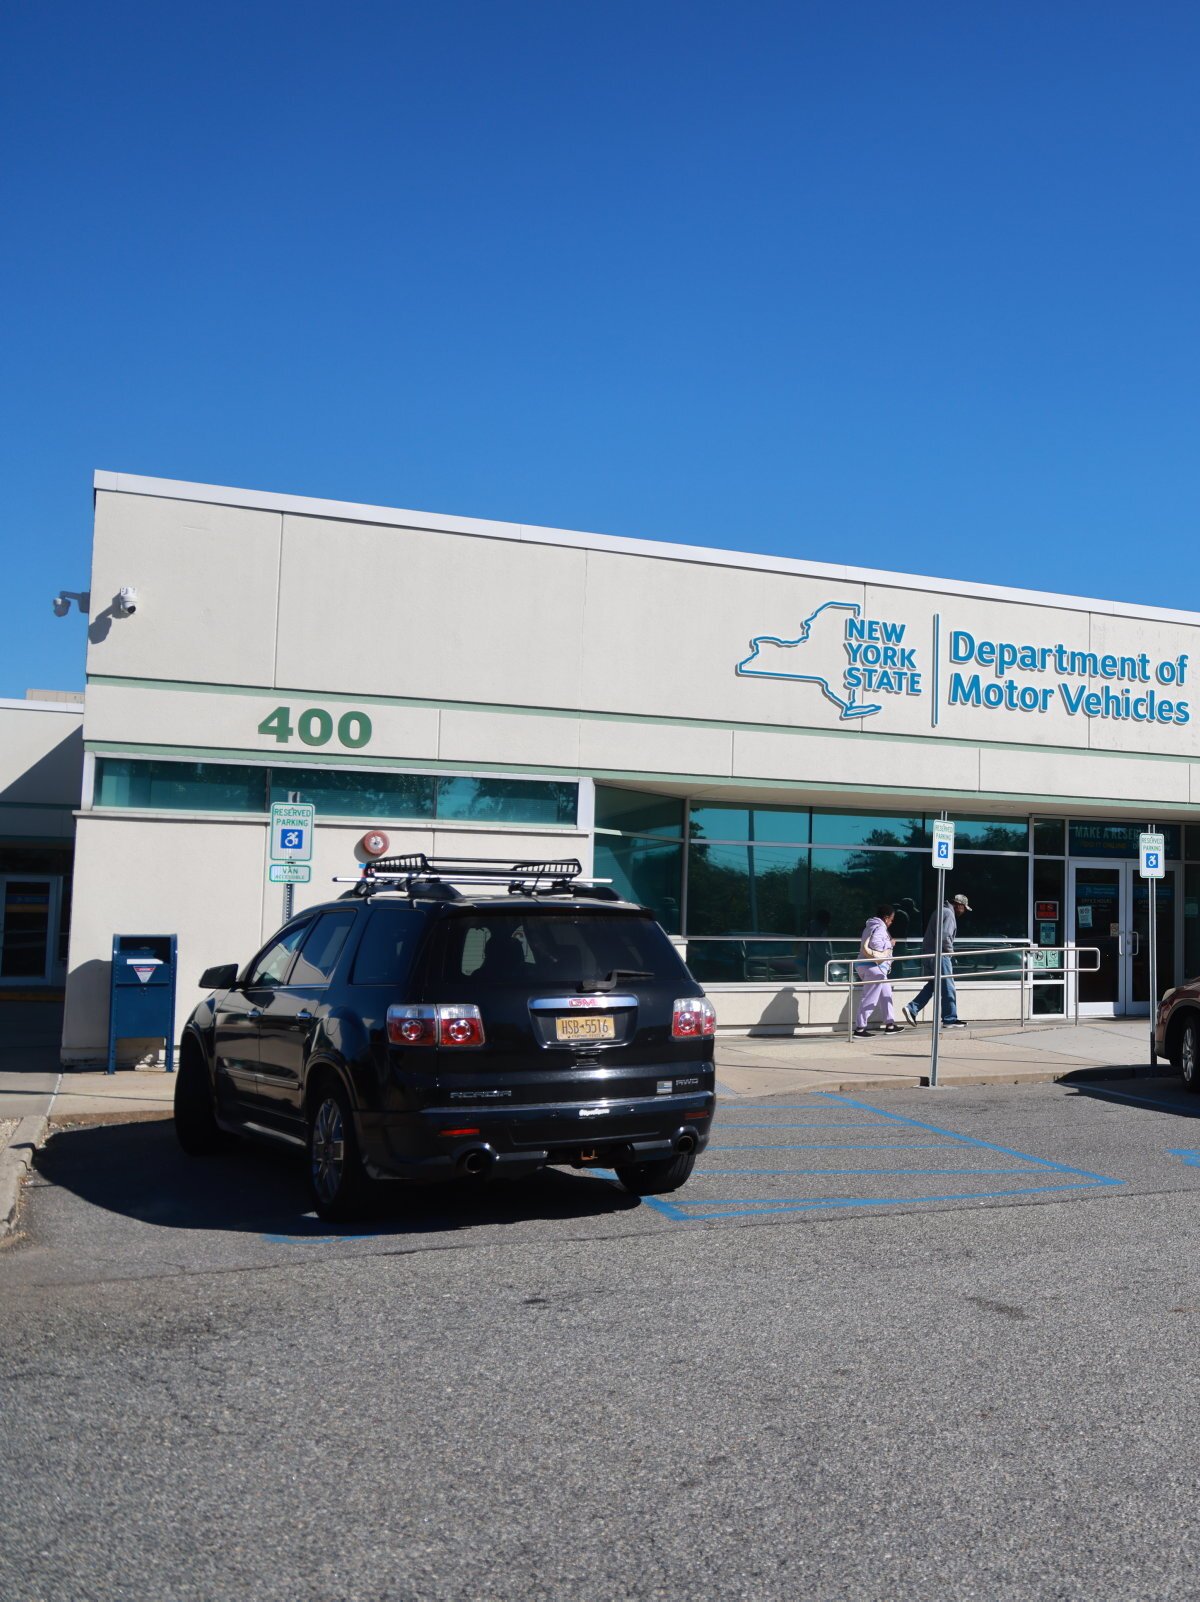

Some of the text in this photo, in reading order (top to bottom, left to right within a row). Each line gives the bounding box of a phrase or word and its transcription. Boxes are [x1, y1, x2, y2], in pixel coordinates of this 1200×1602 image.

[847, 618, 906, 643] NEW
[846, 642, 917, 669] YORK
[951, 630, 1190, 685] Department of
[846, 666, 922, 693] STATE
[951, 672, 1191, 723] Motor Vehicles
[257, 706, 373, 749] 400
[274, 808, 311, 817] RESERVED
[276, 818, 309, 827] PARKING
[1141, 837, 1163, 845] RESERVED
[449, 1089, 512, 1099] ACADIA
[675, 1078, 699, 1086] AWD
